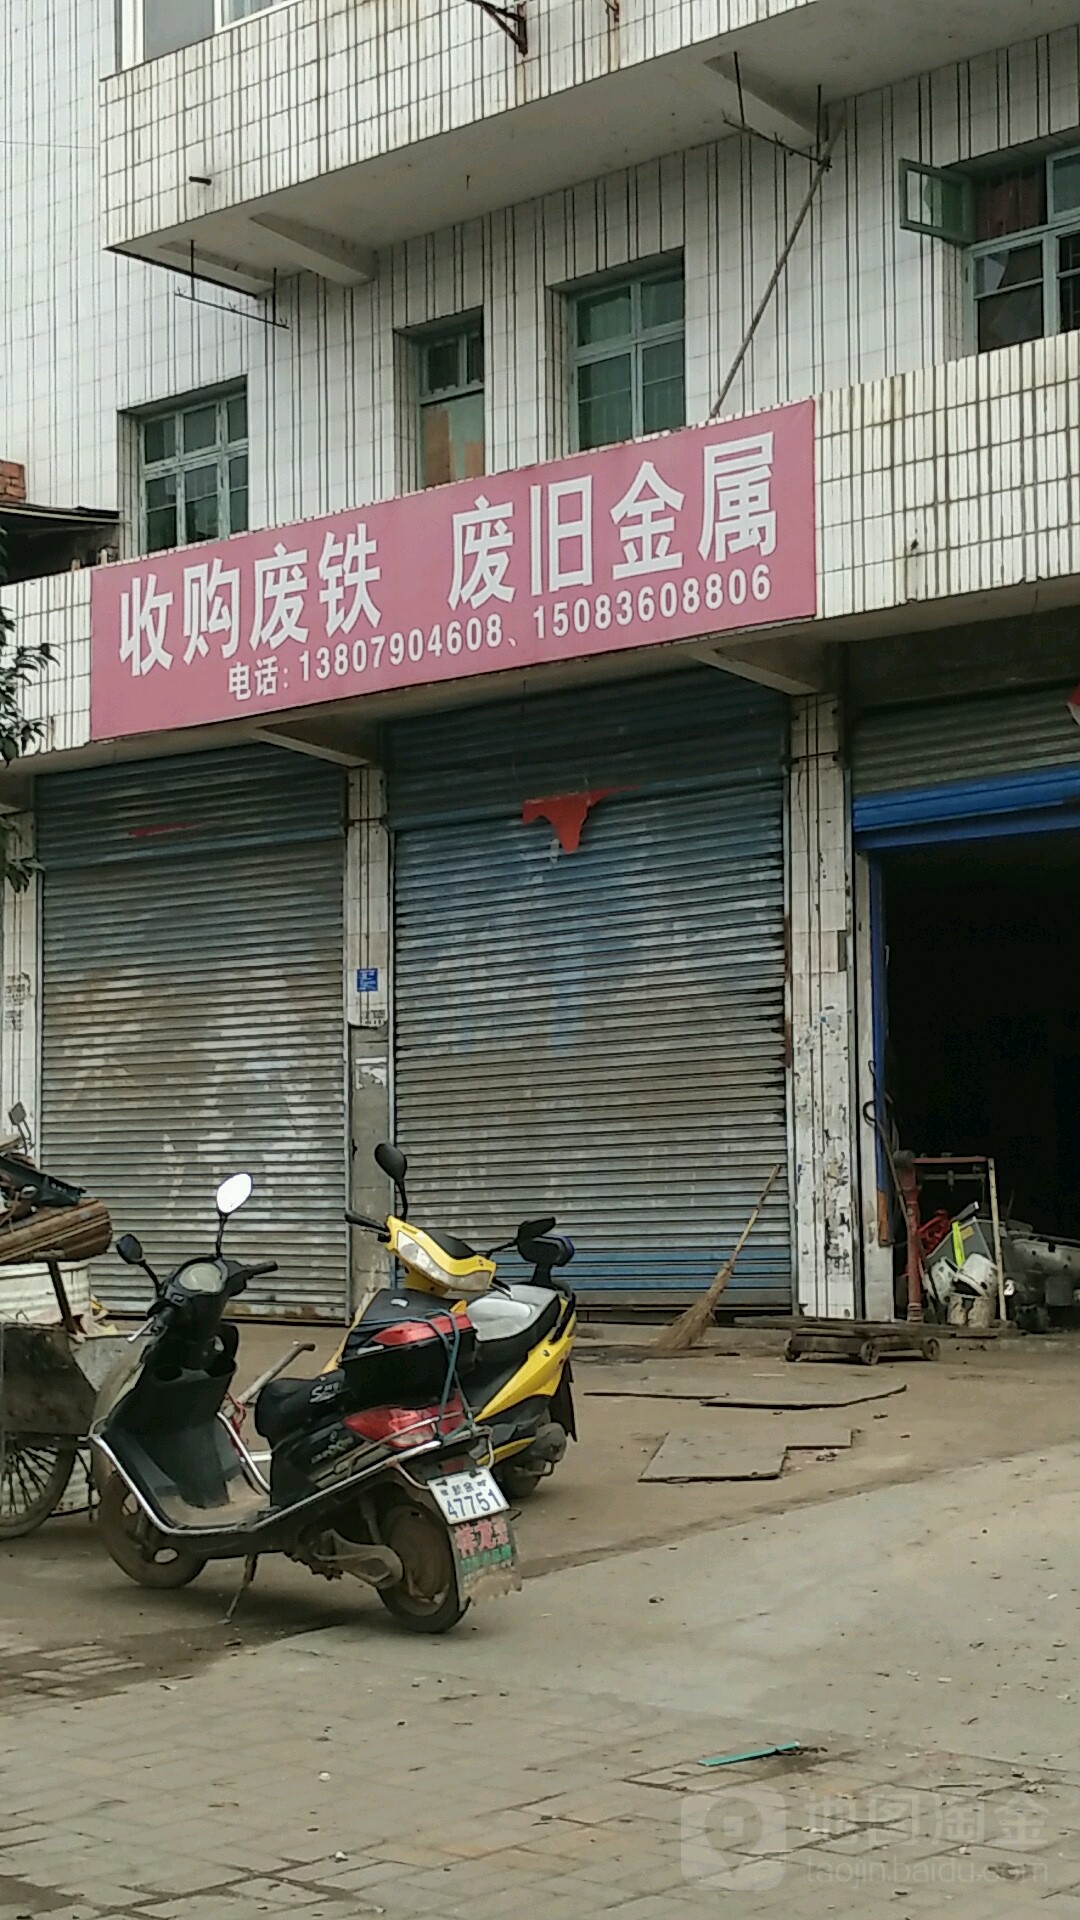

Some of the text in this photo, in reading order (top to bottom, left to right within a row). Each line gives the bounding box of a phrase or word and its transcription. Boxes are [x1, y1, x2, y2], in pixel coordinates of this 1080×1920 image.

[119, 432, 775, 677] 收购废铁 废旧金属
[447, 1489, 501, 1518] 47751
